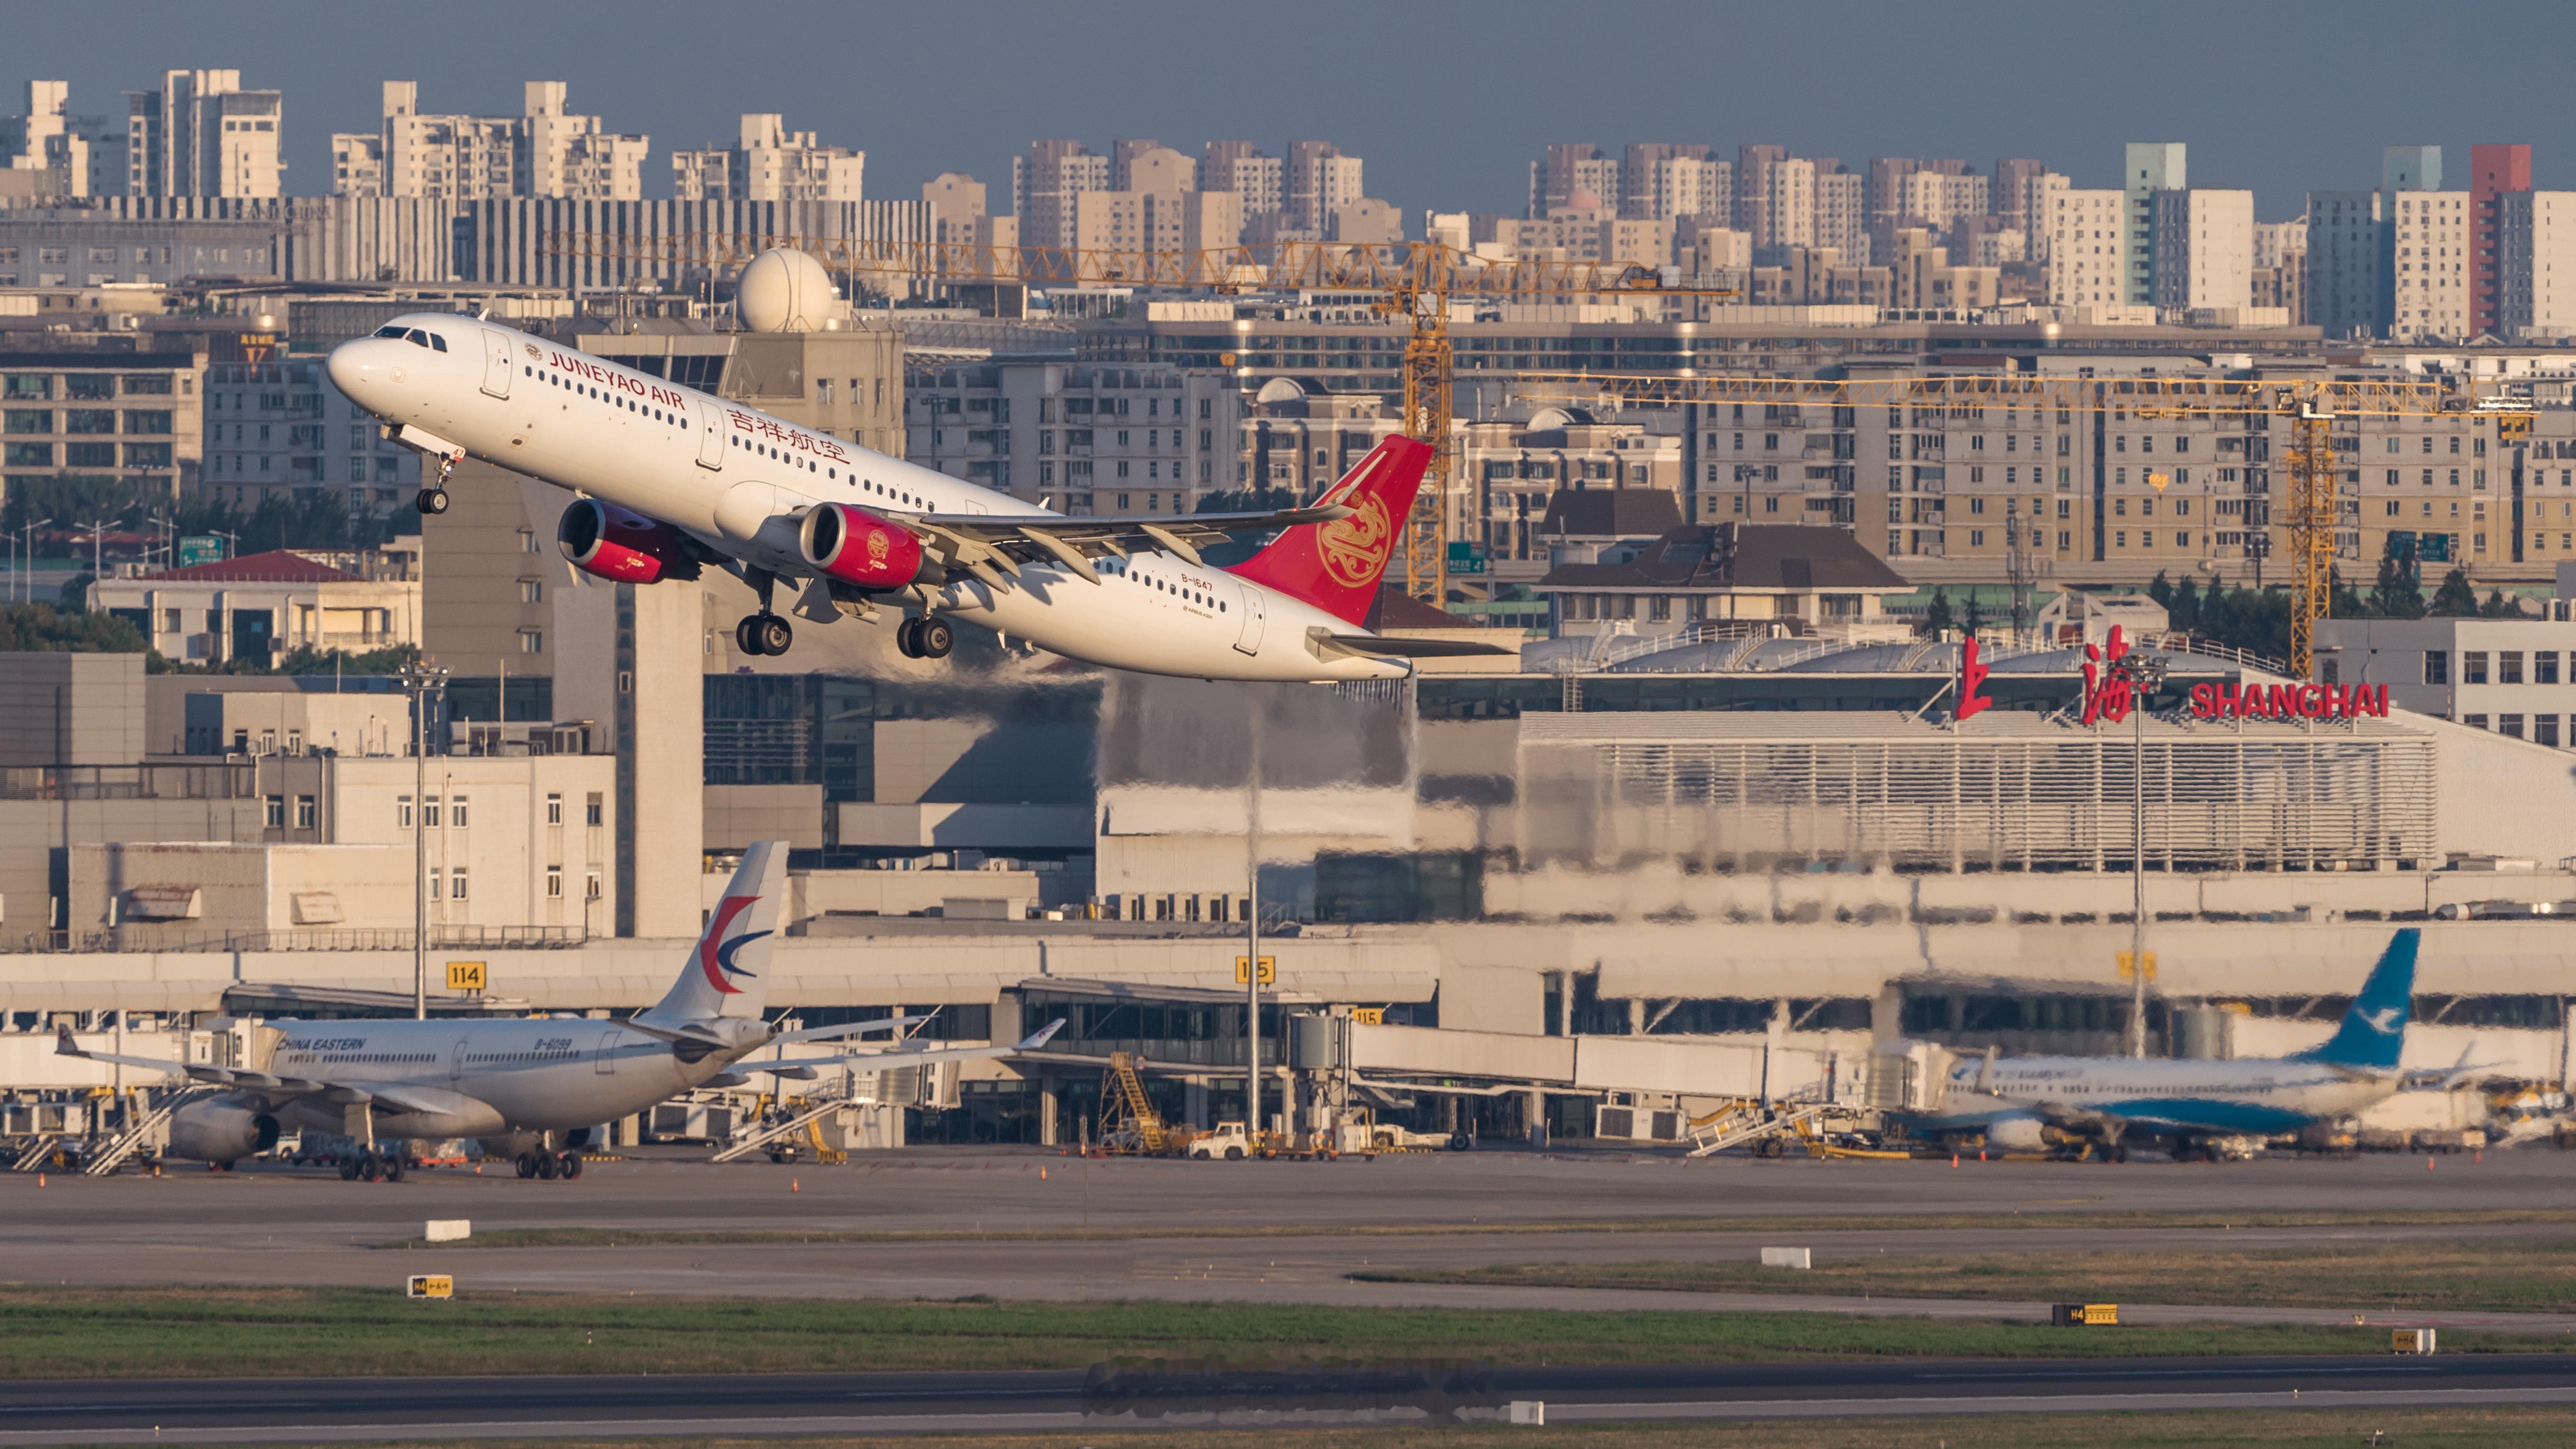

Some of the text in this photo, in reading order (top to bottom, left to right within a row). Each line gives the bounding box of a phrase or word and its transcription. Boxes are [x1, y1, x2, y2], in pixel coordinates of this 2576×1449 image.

[550, 352, 686, 411] JUNEYAO AIR
[726, 409, 851, 465] 吉祥航空
[1181, 573, 1212, 591] B-1647
[2191, 683, 2388, 718] SHANGHAI
[453, 967, 479, 983] 114
[1242, 961, 1268, 978] 15
[1358, 1012, 1376, 1024] 115
[277, 1038, 367, 1051] CHINA EASTERN
[2071, 1309, 2084, 1320] H4
